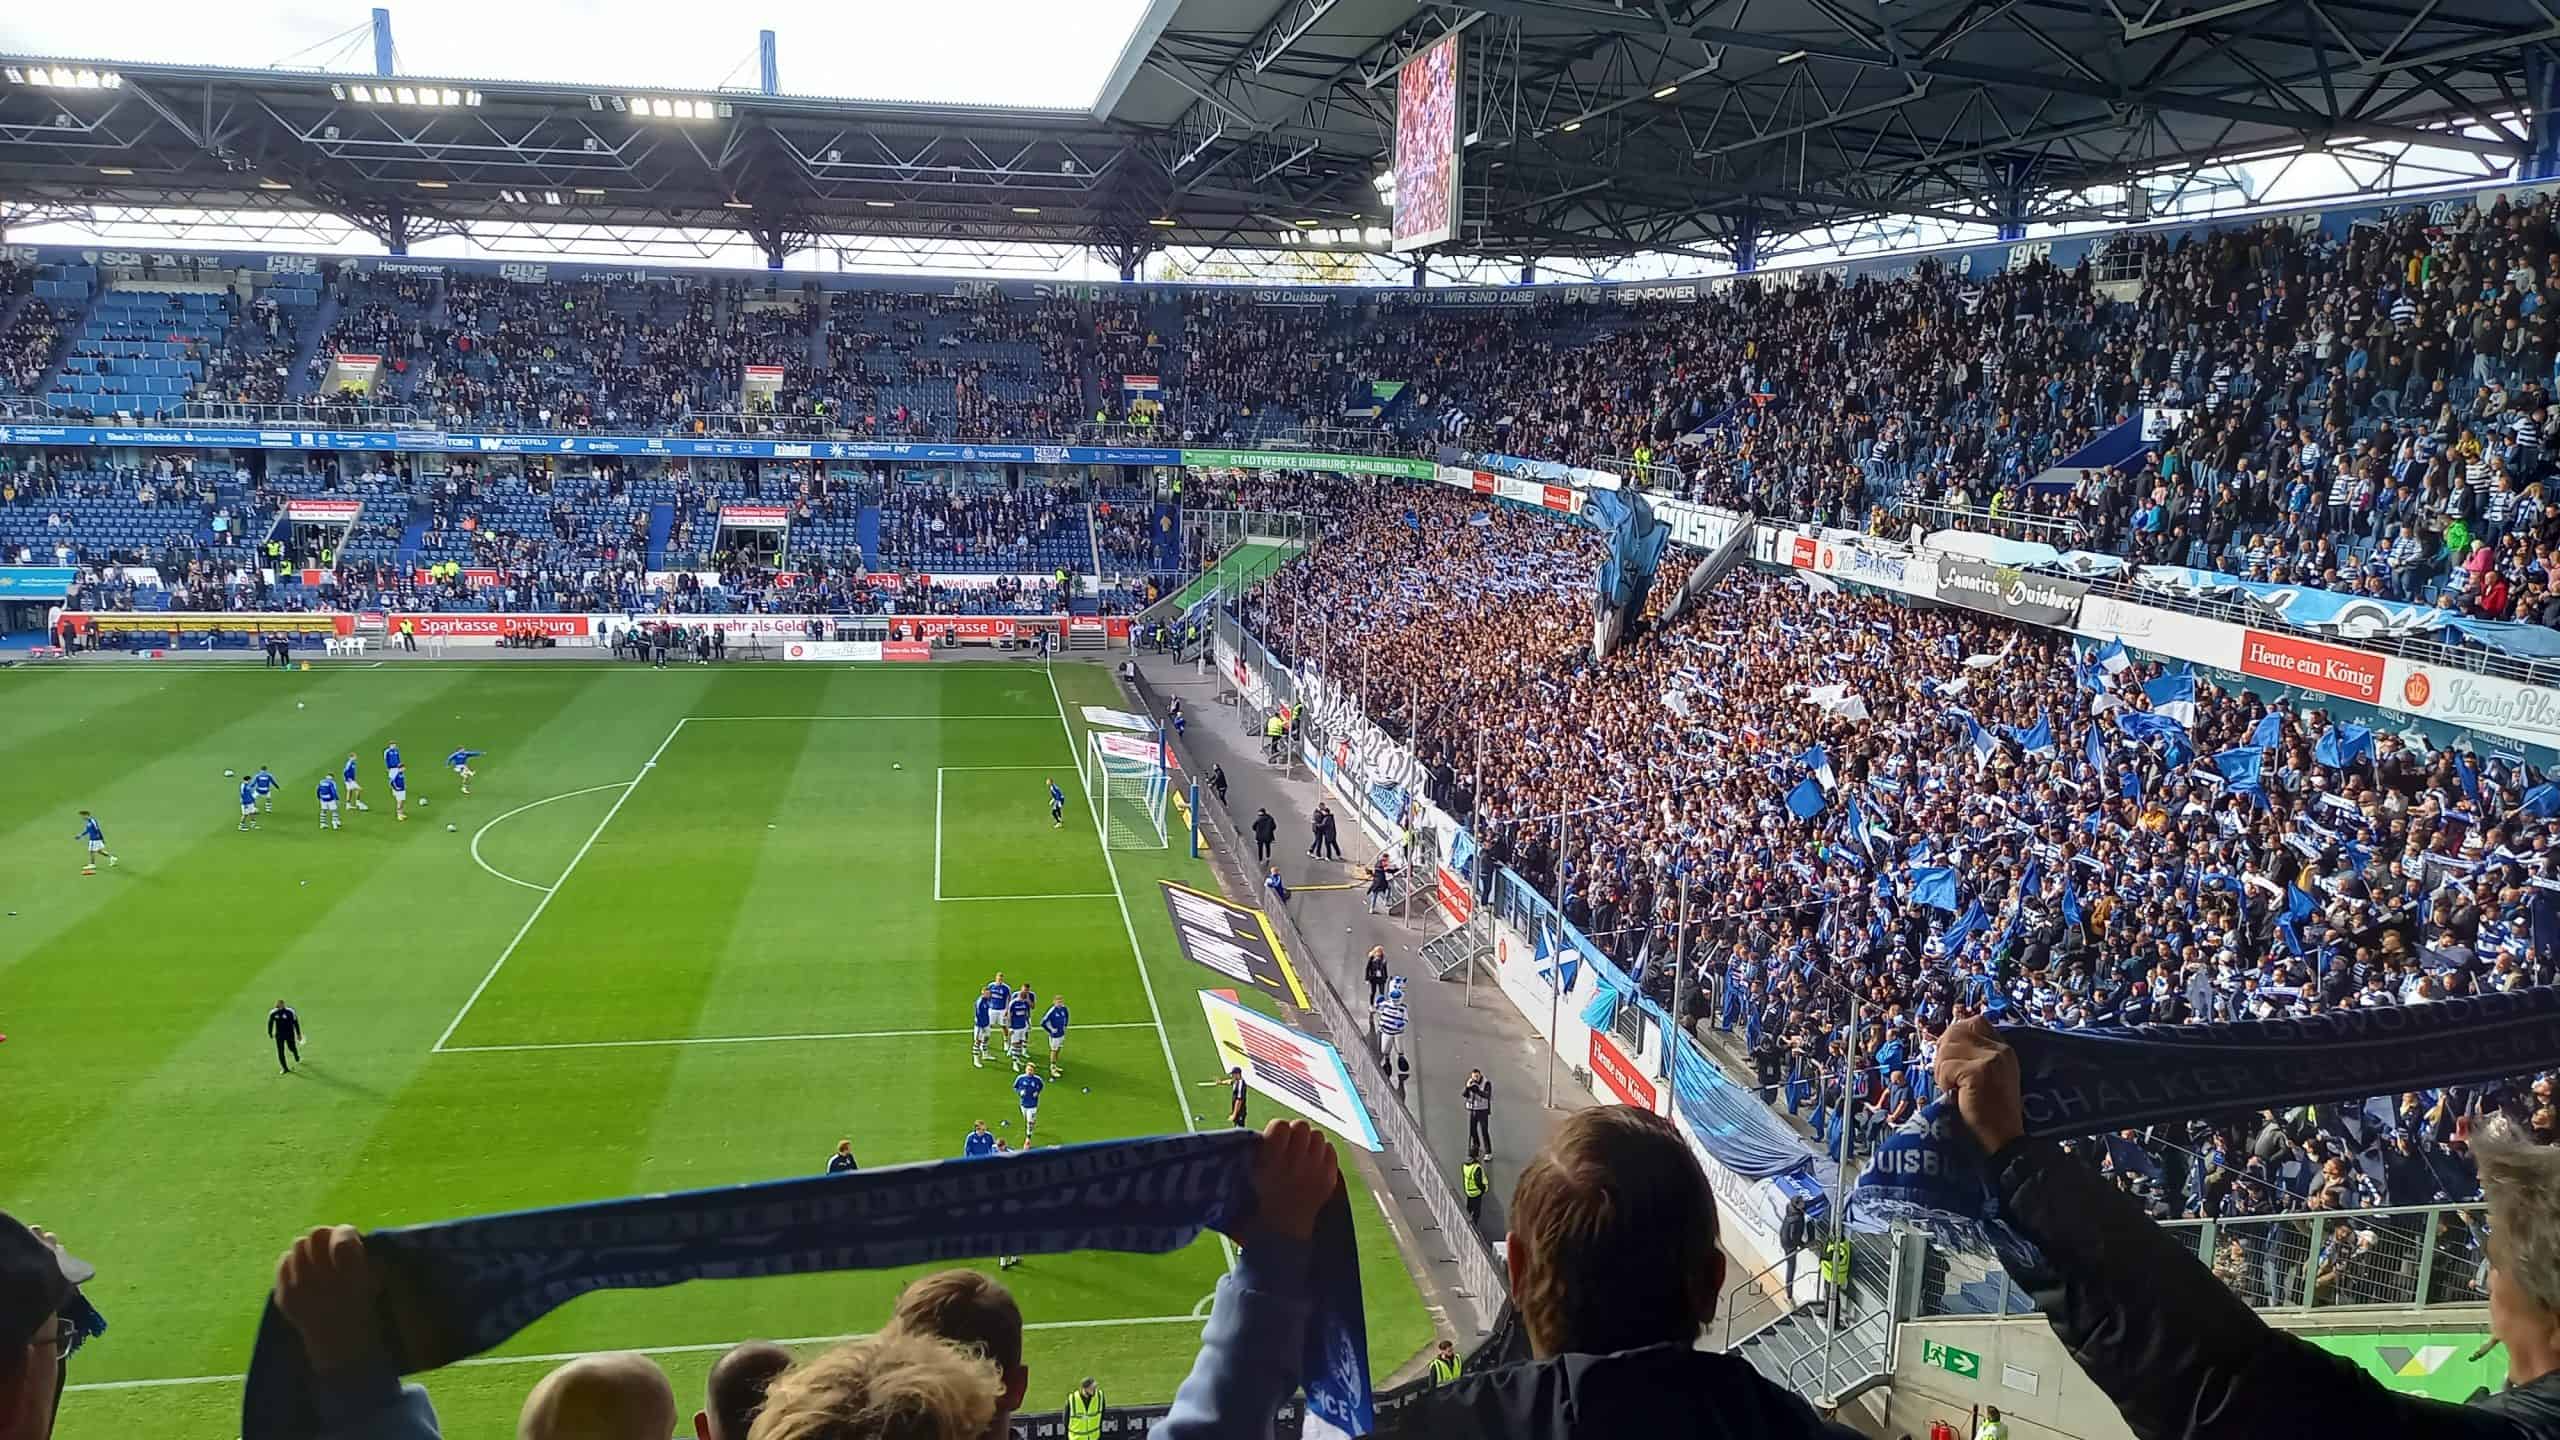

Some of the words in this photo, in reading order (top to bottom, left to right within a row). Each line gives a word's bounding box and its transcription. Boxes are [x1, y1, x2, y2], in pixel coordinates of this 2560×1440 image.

[1749, 271, 1803, 294] ROHNE
[1444, 292, 1467, 303] WIR
[1468, 291, 1498, 303] SIND
[1500, 290, 1536, 303] DABEI
[1606, 286, 1696, 303] RHEINPOWER
[1230, 455, 1298, 467] STADTWERKE
[420, 618, 498, 633] Sparkasse
[751, 620, 771, 632] als
[919, 620, 989, 636] Spakasse
[2249, 642, 2296, 674] Heute
[2296, 654, 2322, 677] ein
[2324, 658, 2375, 696] König
[2443, 677, 2513, 727] König
[2023, 1064, 2252, 1122] CHALKER
